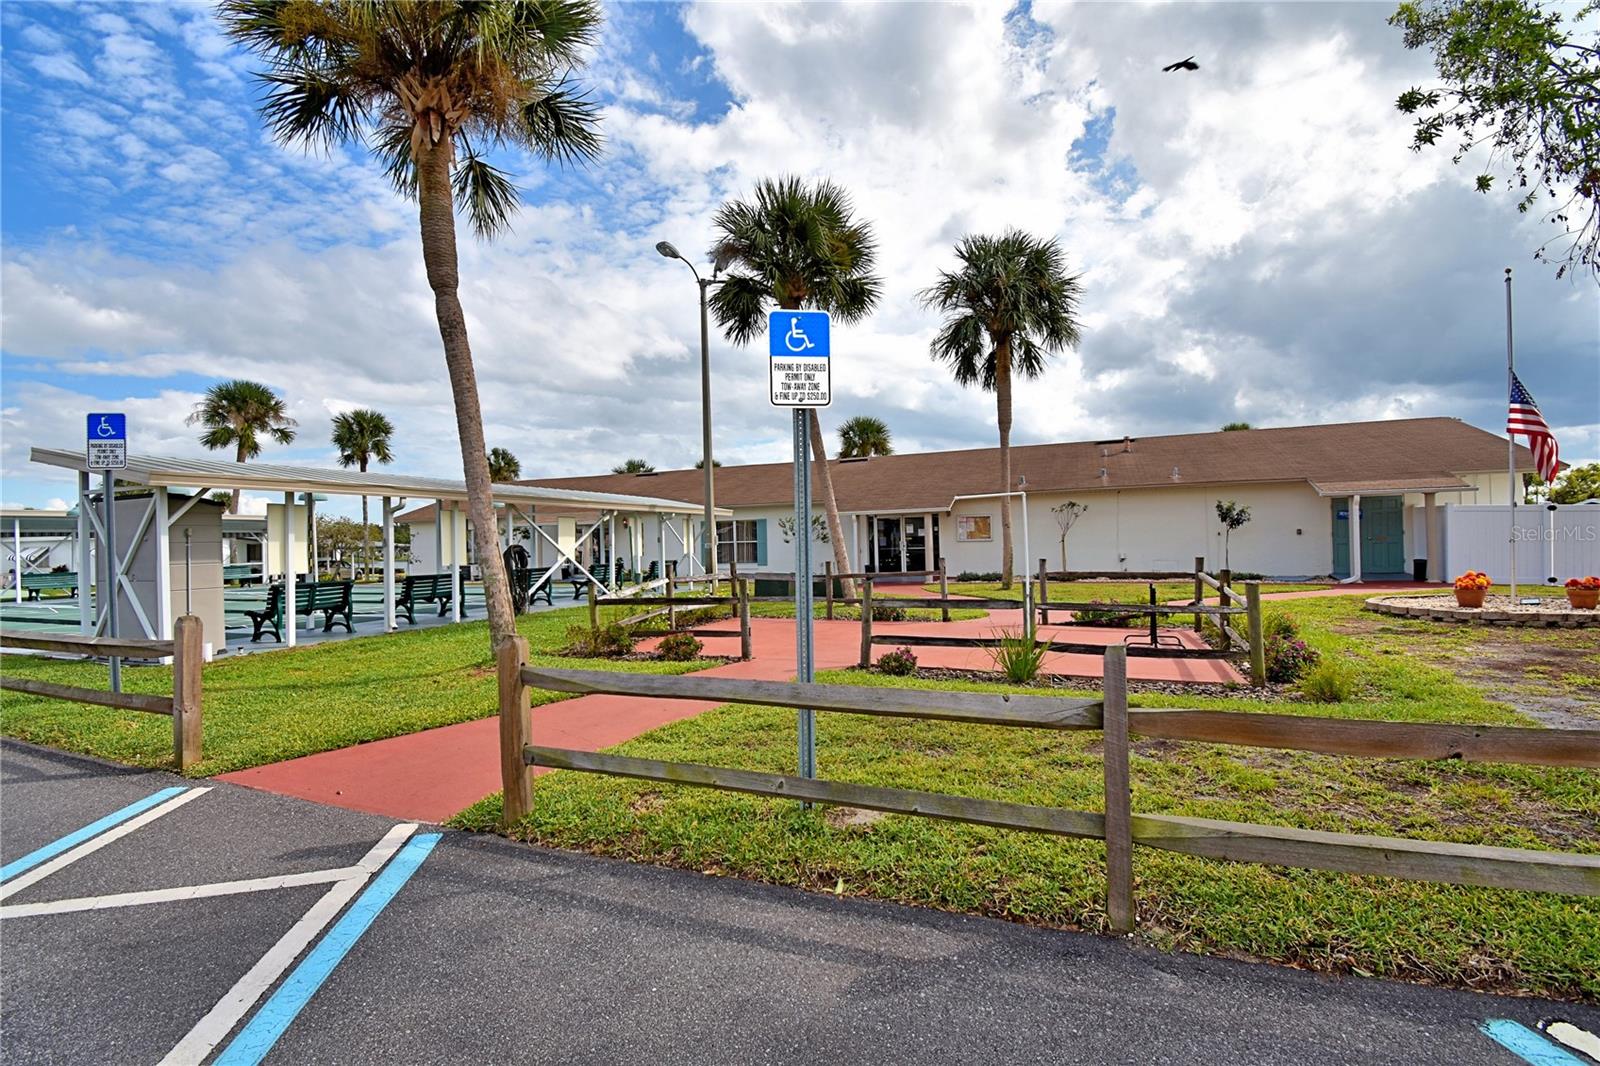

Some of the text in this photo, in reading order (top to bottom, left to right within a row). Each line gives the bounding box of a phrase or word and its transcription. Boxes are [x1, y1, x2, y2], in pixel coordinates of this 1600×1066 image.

[774, 363, 826, 372] PARKING BY DISABLED
[785, 373, 815, 381] PERMIT ONLY
[808, 382, 820, 391] ZONE
[779, 392, 790, 400] FINE
[791, 392, 798, 400] UP
